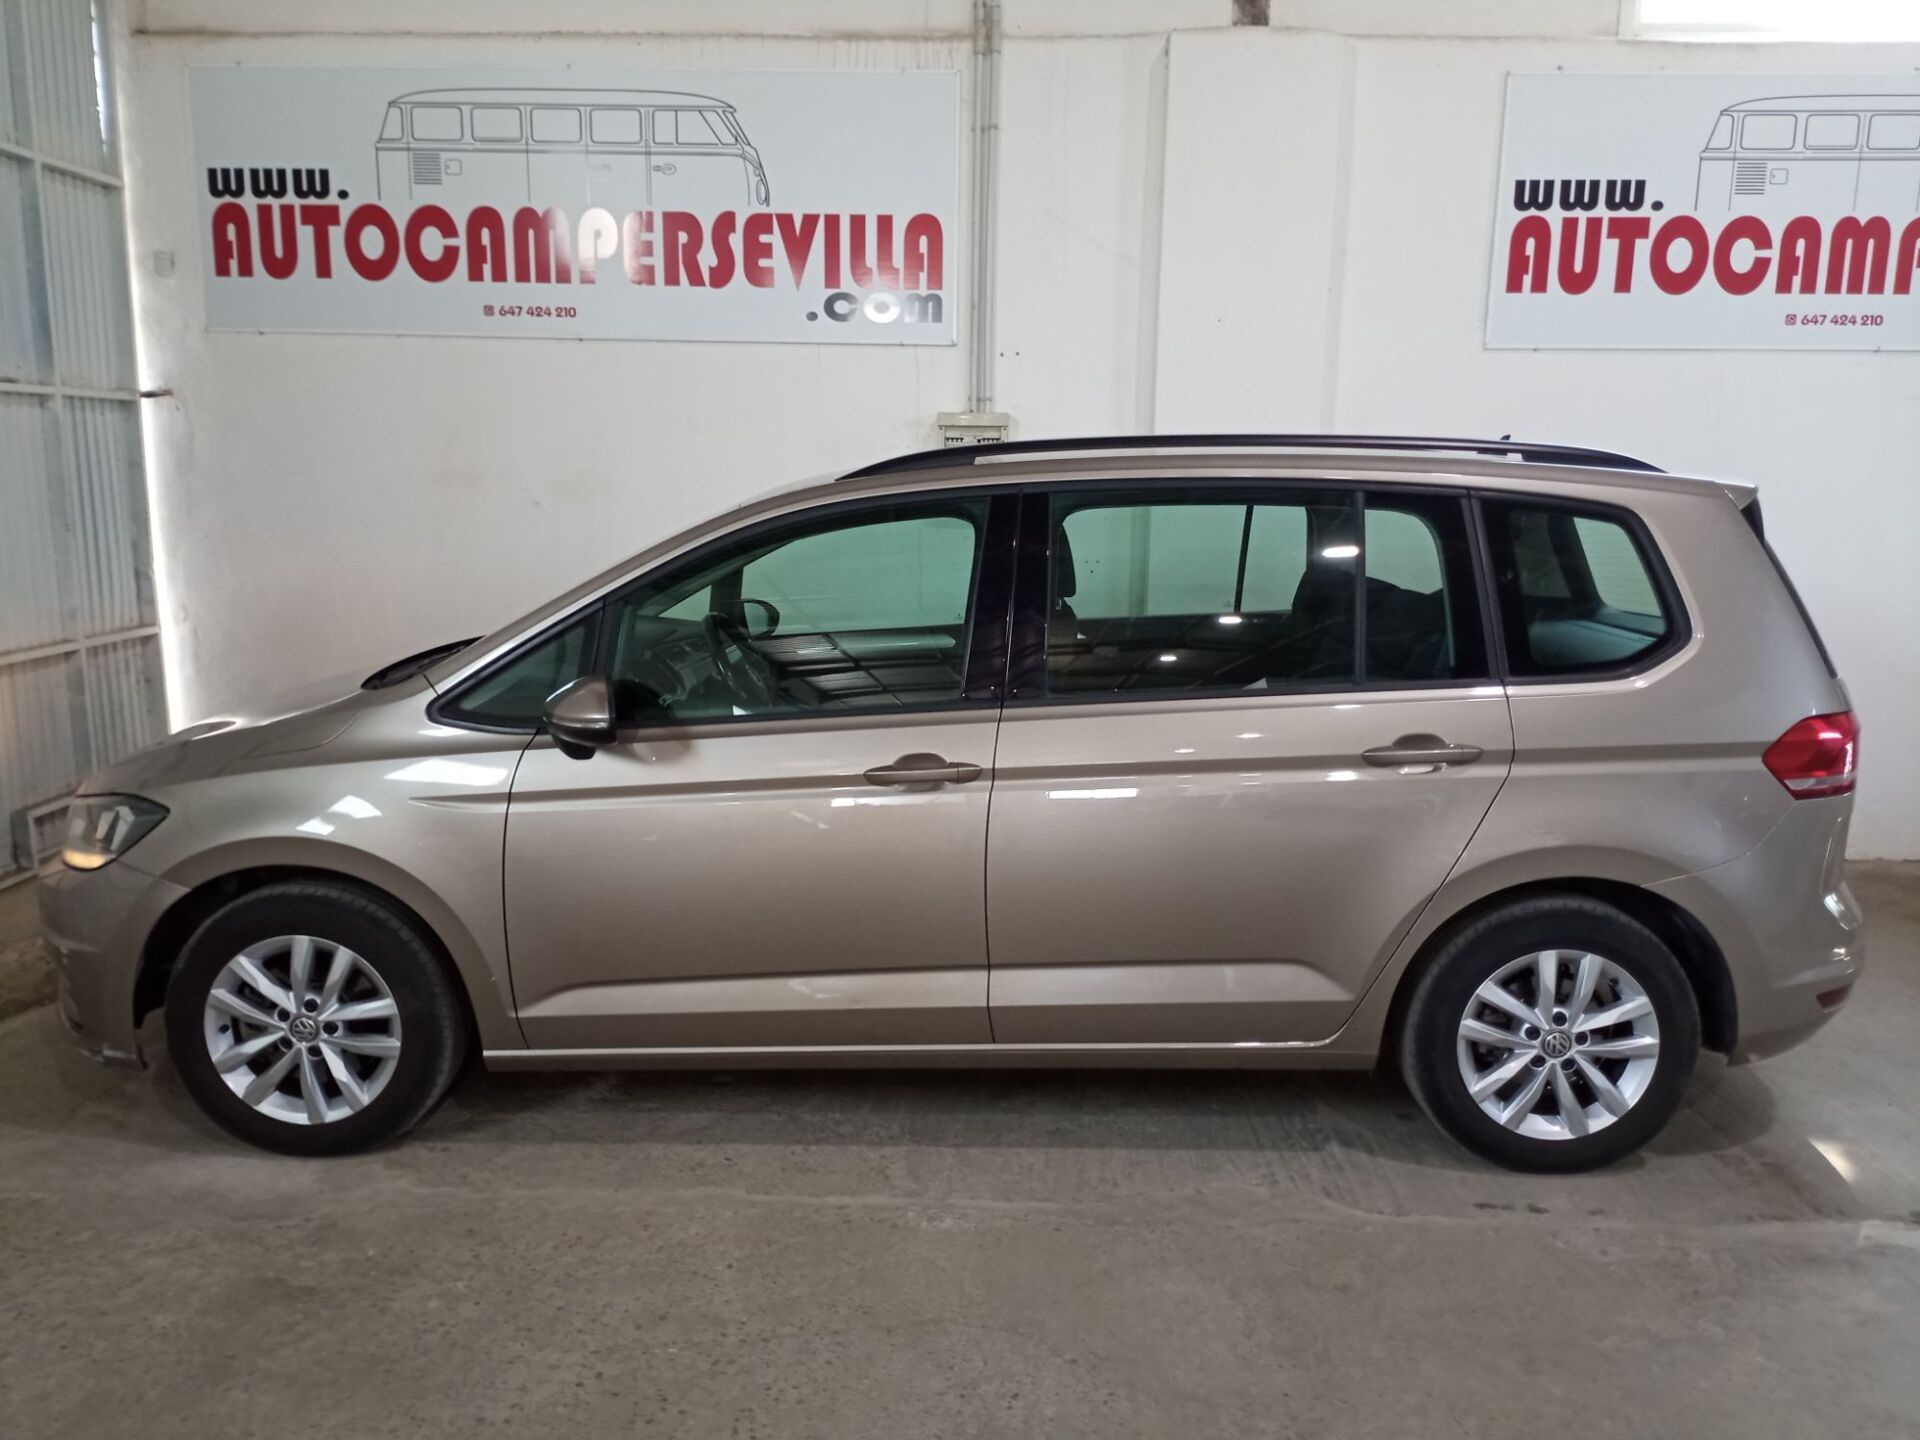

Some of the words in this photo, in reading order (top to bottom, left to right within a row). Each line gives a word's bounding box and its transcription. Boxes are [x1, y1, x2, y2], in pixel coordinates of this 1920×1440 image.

[207, 167, 349, 199] www.
[1513, 179, 1664, 212] www.
[211, 201, 944, 290] AUTOCAMPERSEVILLA
[498, 305, 523, 317] 647
[526, 306, 552, 318] 424
[555, 306, 577, 318] 210
[1800, 314, 1827, 326] 647
[1830, 314, 1857, 326] 424
[1860, 314, 1884, 326] 210
